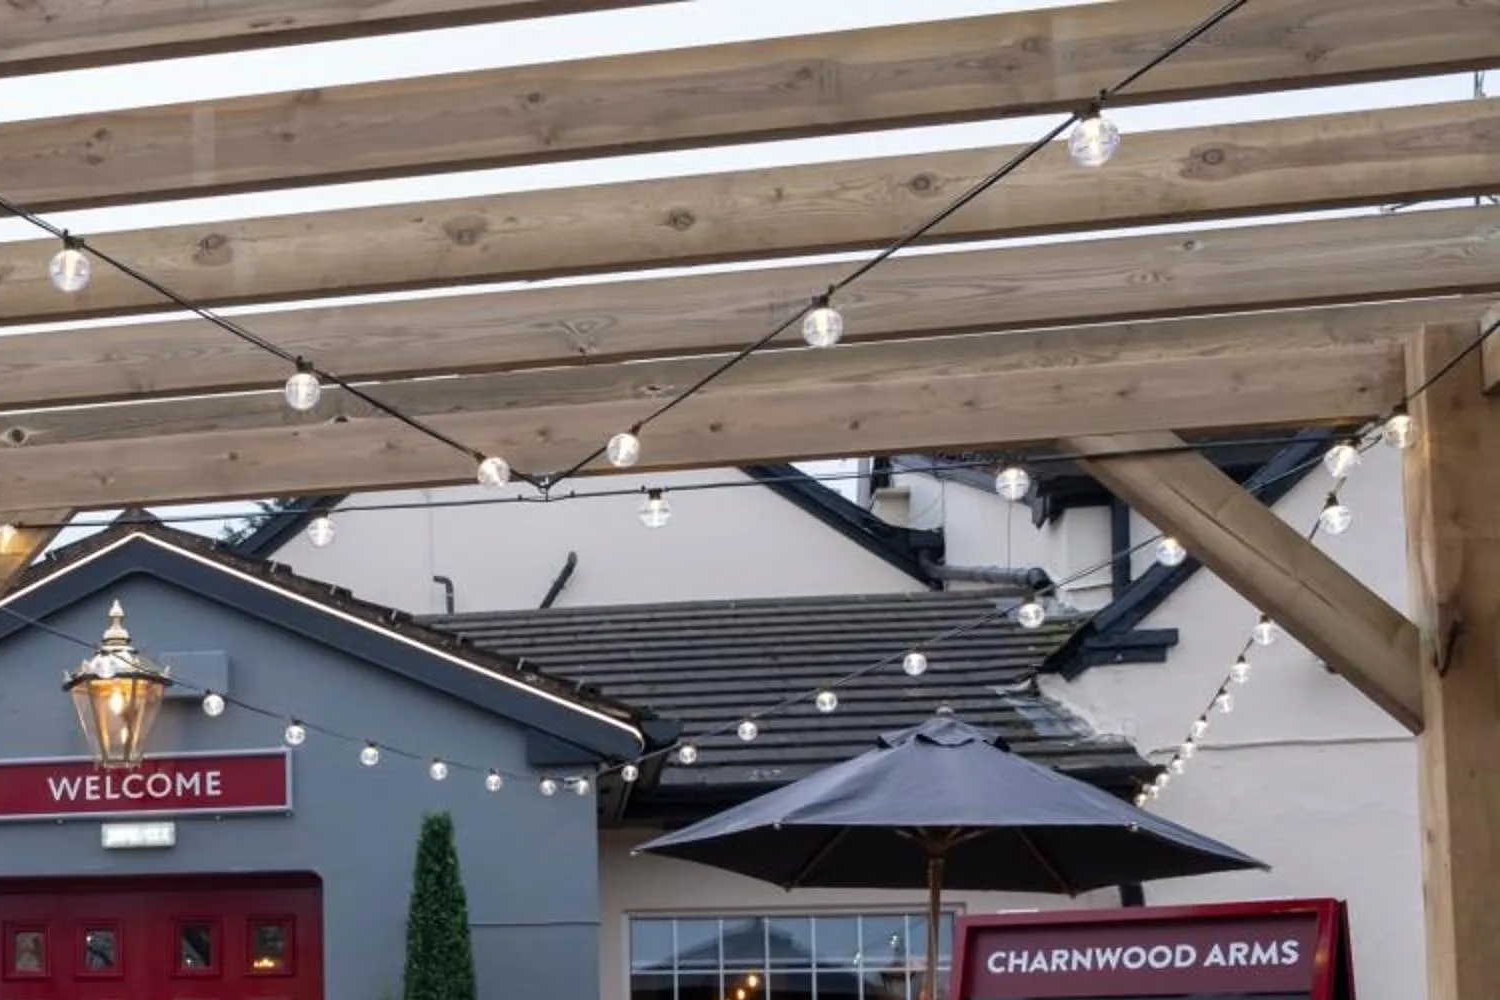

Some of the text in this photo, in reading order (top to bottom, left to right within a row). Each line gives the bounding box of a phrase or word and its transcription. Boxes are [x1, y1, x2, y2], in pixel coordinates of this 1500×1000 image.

[48, 770, 223, 803] WELCOME
[987, 940, 1300, 973] CHARNWOOD ARMS
